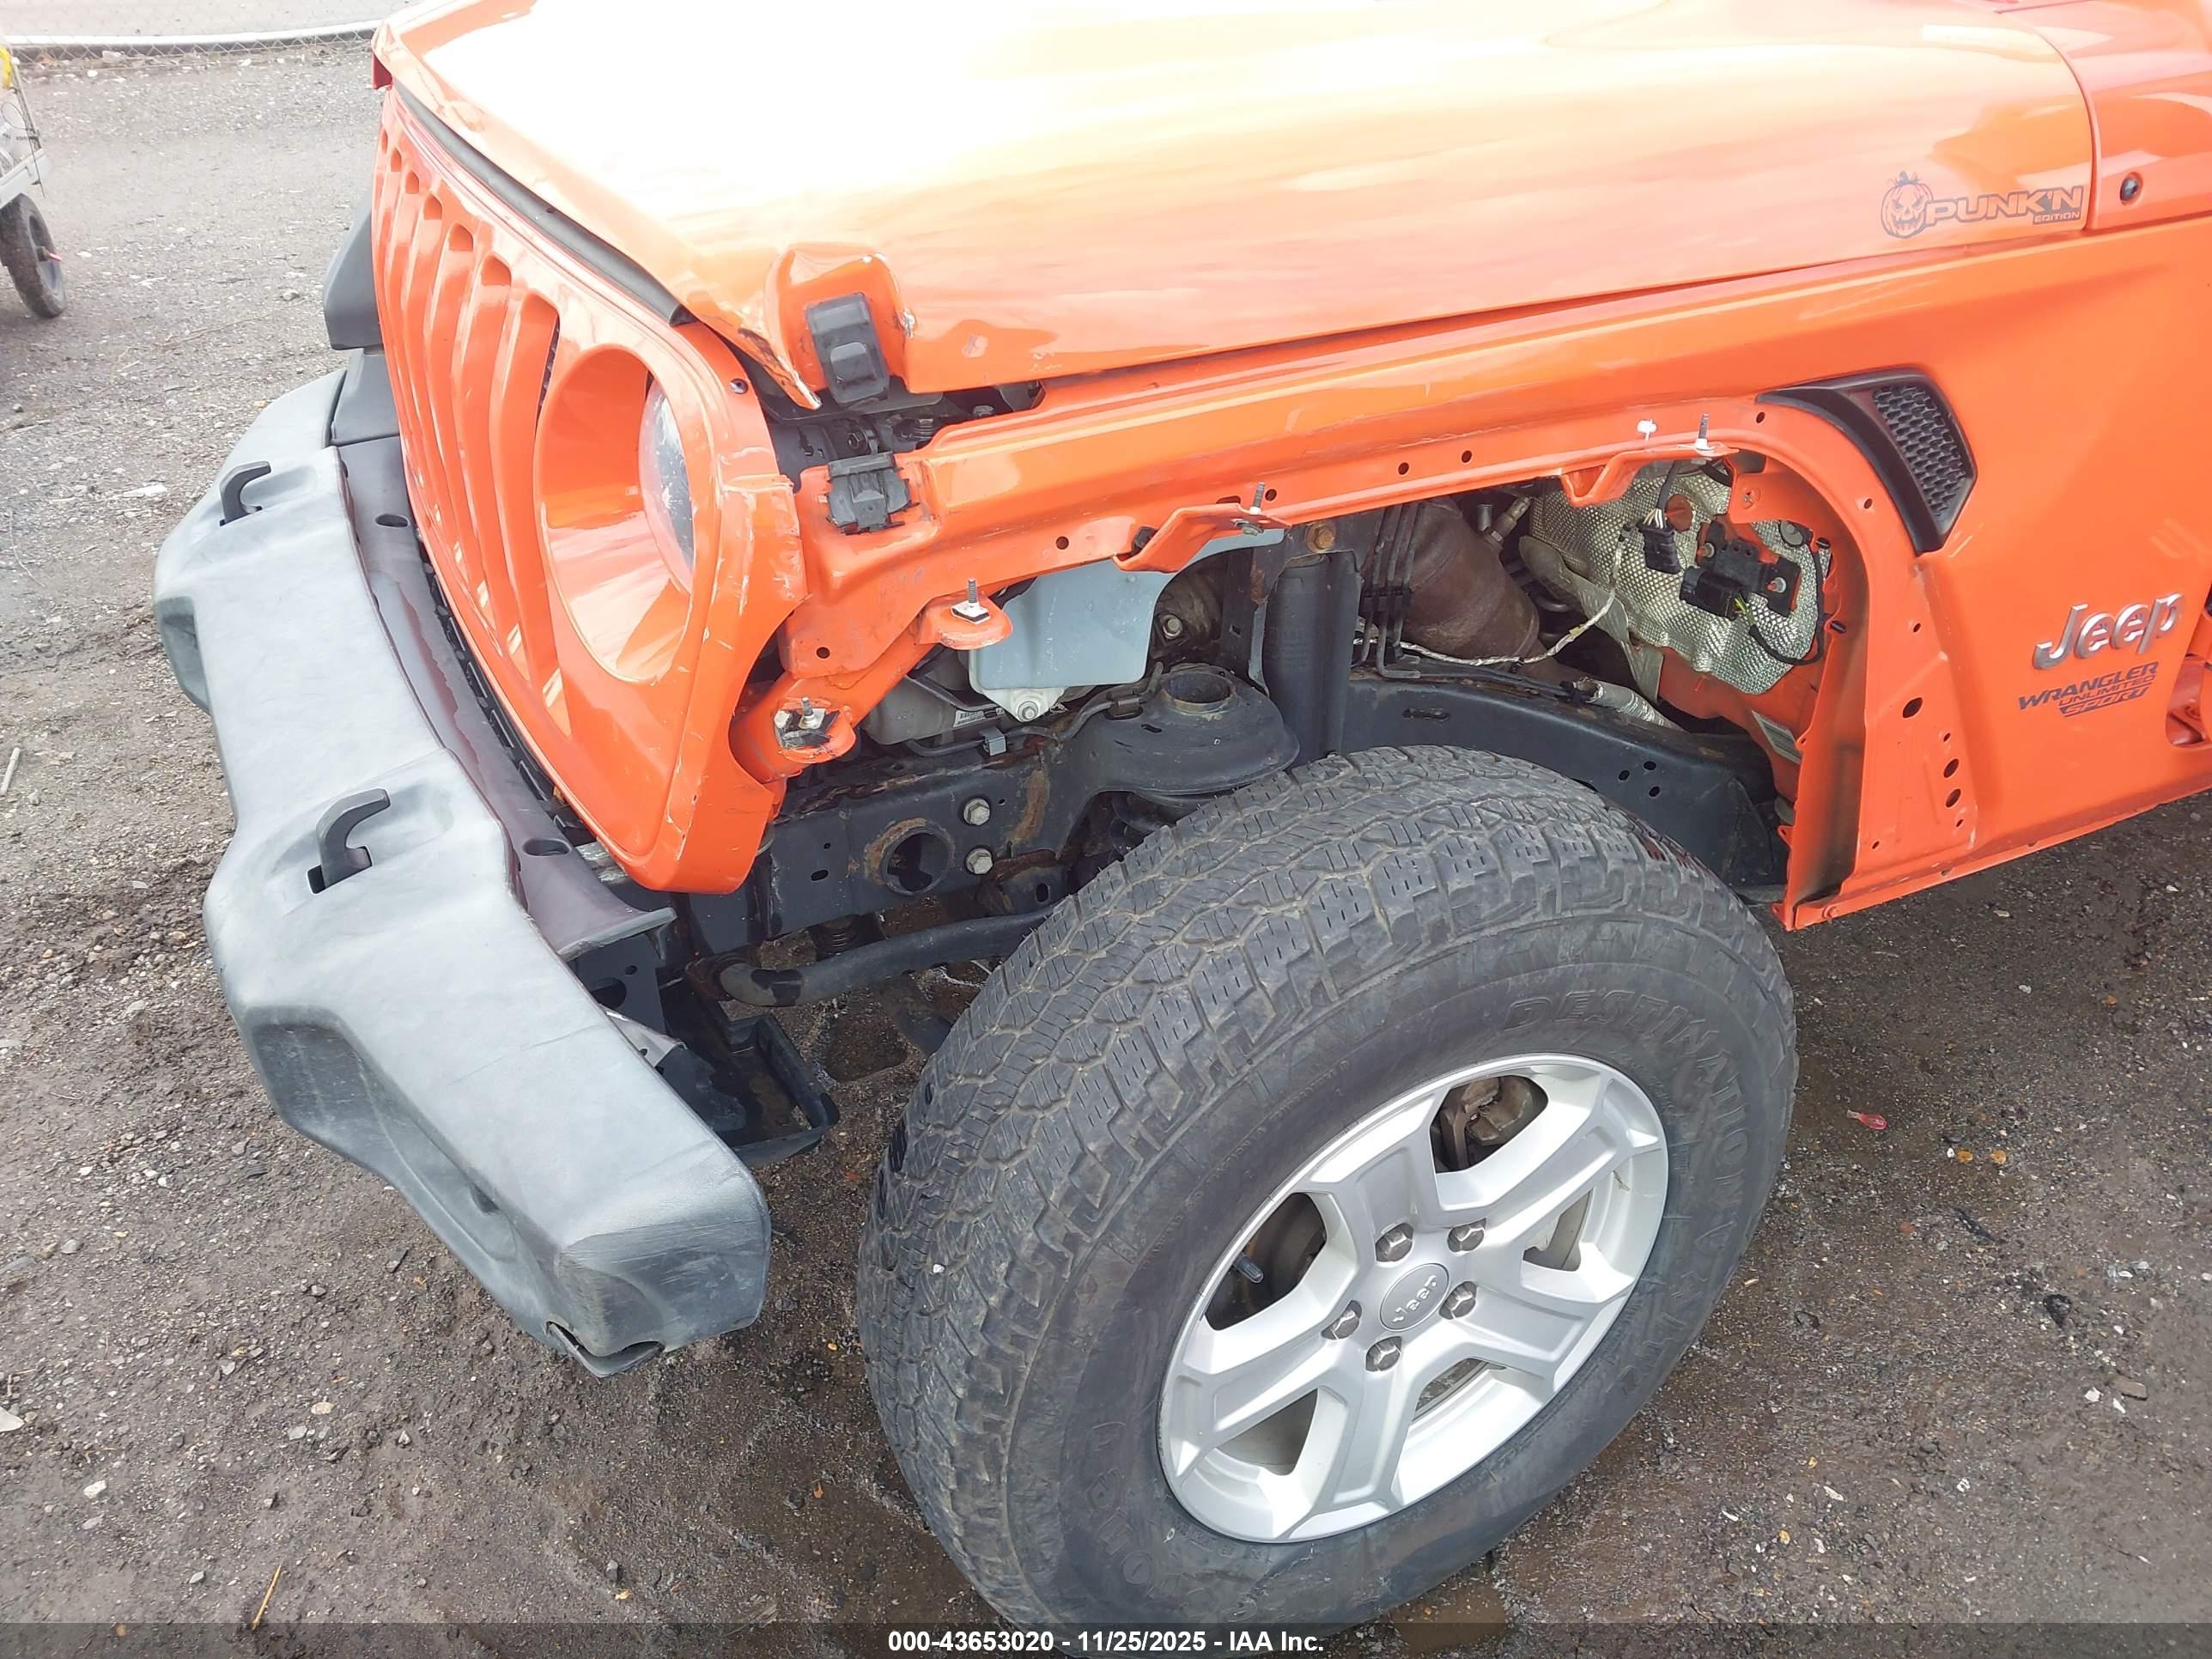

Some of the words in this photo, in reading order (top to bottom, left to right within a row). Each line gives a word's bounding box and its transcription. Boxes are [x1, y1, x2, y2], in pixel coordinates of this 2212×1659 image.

[1926, 185, 2084, 227] PUNK'N
[2033, 212, 2081, 225] EDITION
[2033, 592, 2184, 670] Jeep
[2019, 661, 2159, 710] WRANGLER
[2059, 675, 2156, 706] UNLIMITED
